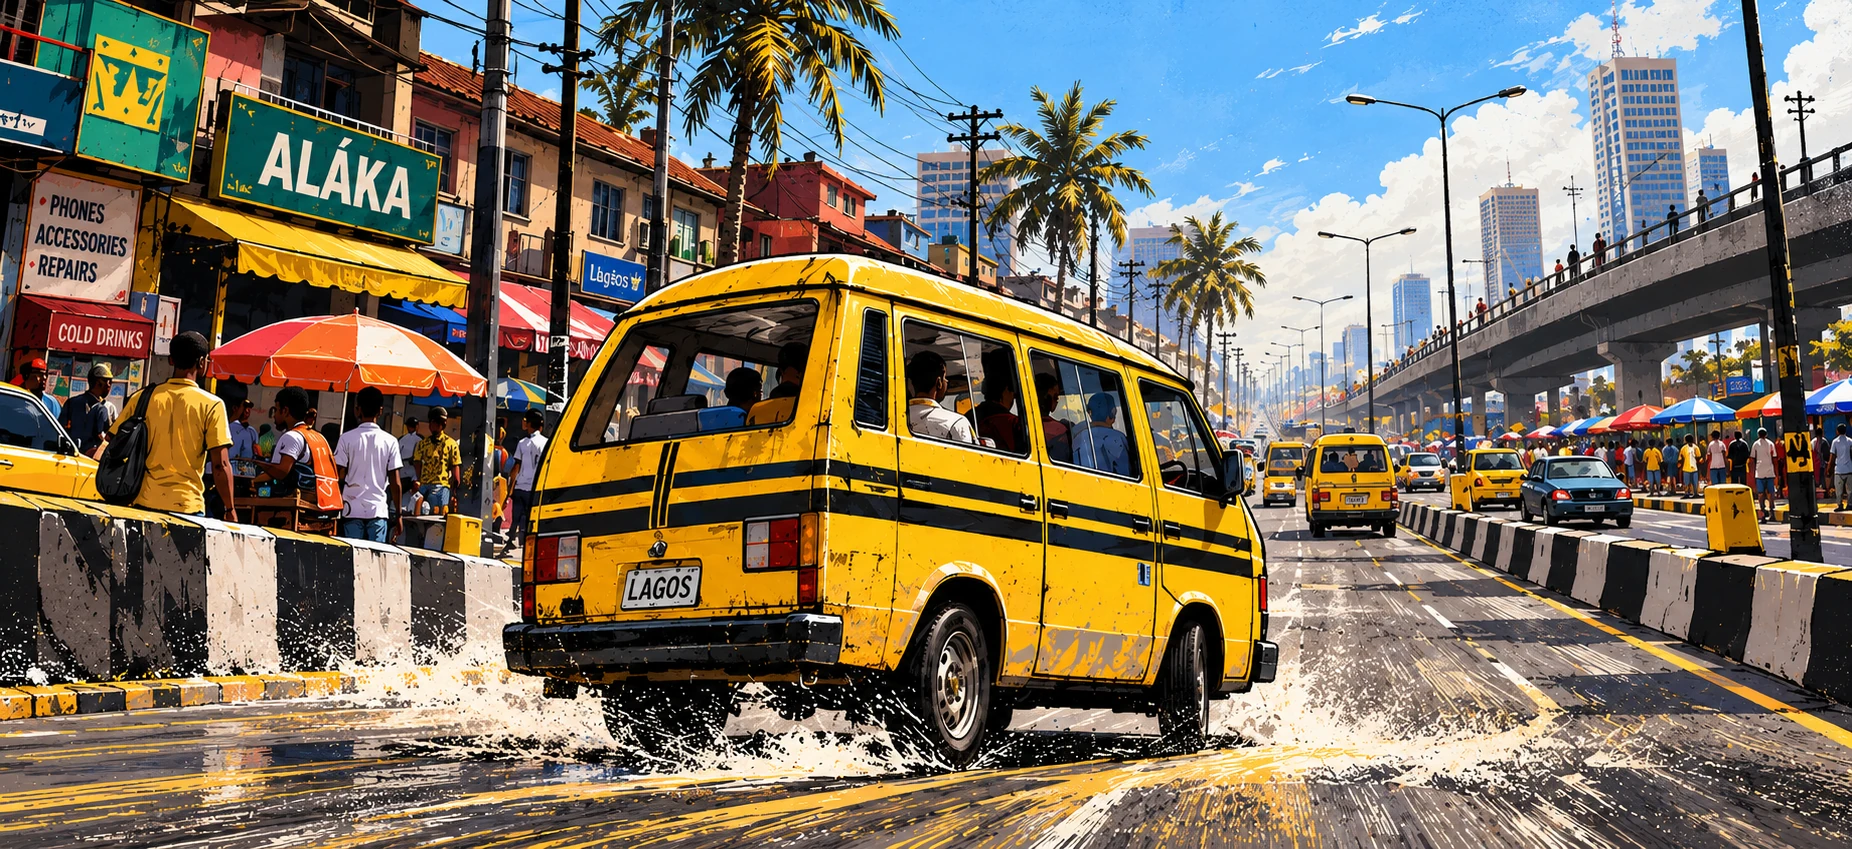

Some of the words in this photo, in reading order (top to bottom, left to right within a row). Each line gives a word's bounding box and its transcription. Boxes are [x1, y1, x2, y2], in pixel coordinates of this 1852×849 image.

[257, 131, 411, 220] ALÁKA
[49, 194, 105, 224] PHONES
[35, 224, 128, 257] ACCESSORIES
[37, 254, 98, 284] REPAIRS
[58, 322, 93, 344] COLD
[96, 327, 144, 350] DRINKS
[627, 574, 692, 601] LAGOS
